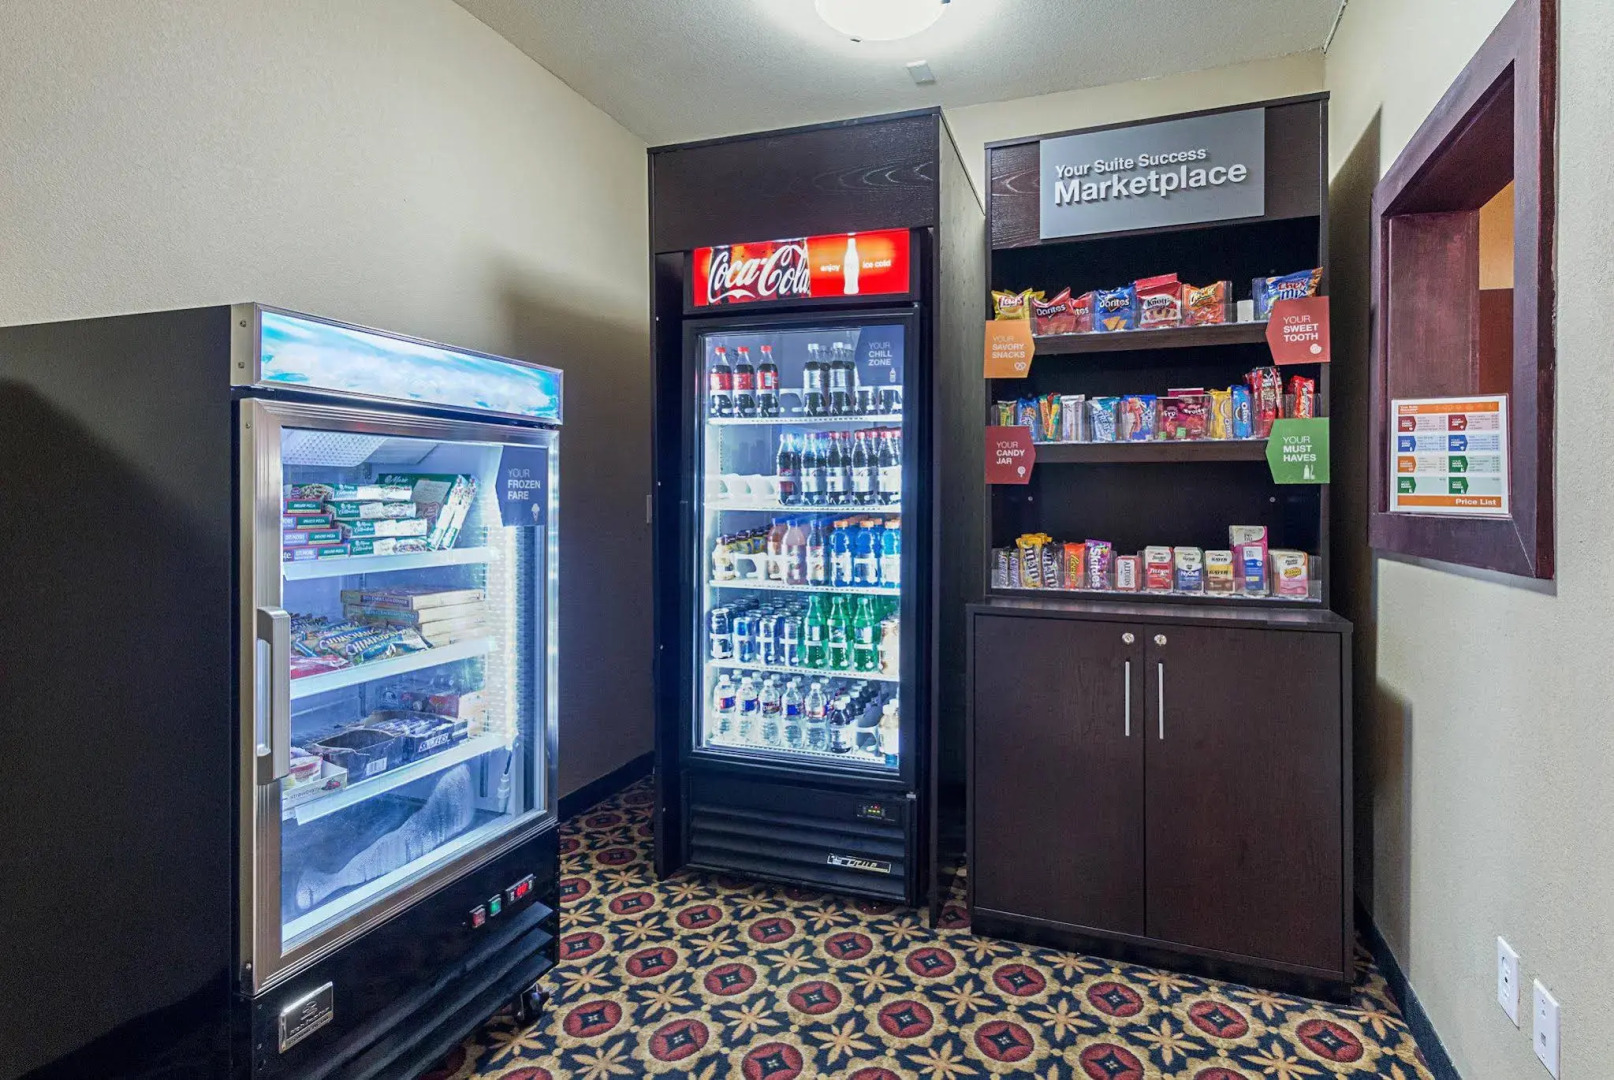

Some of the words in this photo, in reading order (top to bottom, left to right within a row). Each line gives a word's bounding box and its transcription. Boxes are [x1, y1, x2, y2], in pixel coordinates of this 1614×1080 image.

[1055, 164, 1090, 178] Your
[1094, 157, 1134, 173] Suite
[1138, 148, 1207, 167] Success
[1055, 163, 1247, 204] Marketplace
[820, 263, 841, 272] enjoy
[862, 260, 874, 269] ice
[874, 259, 892, 268] cold
[708, 244, 811, 303] Coca-Cola
[1036, 304, 1066, 316] Doritos
[1283, 315, 1311, 325] YOUR
[1283, 323, 1319, 334] SWEET
[1283, 333, 1319, 342] TOOTH
[868, 342, 890, 350] YOUR
[868, 350, 893, 358] CHILL
[992, 351, 1025, 359] SNACKS
[868, 358, 892, 367] ZONE
[1283, 435, 1311, 444] YOUR
[996, 441, 1019, 449] YOUR
[1283, 445, 1313, 453] MUST
[996, 449, 1025, 457] CANDY
[1283, 453, 1317, 462] HAVES
[996, 457, 1013, 465] JAR
[508, 468, 530, 478] YOUR
[508, 479, 541, 489] FROZEN
[508, 490, 529, 500] FARE
[1480, 498, 1497, 506] List
[1089, 546, 1101, 588] Skittles
